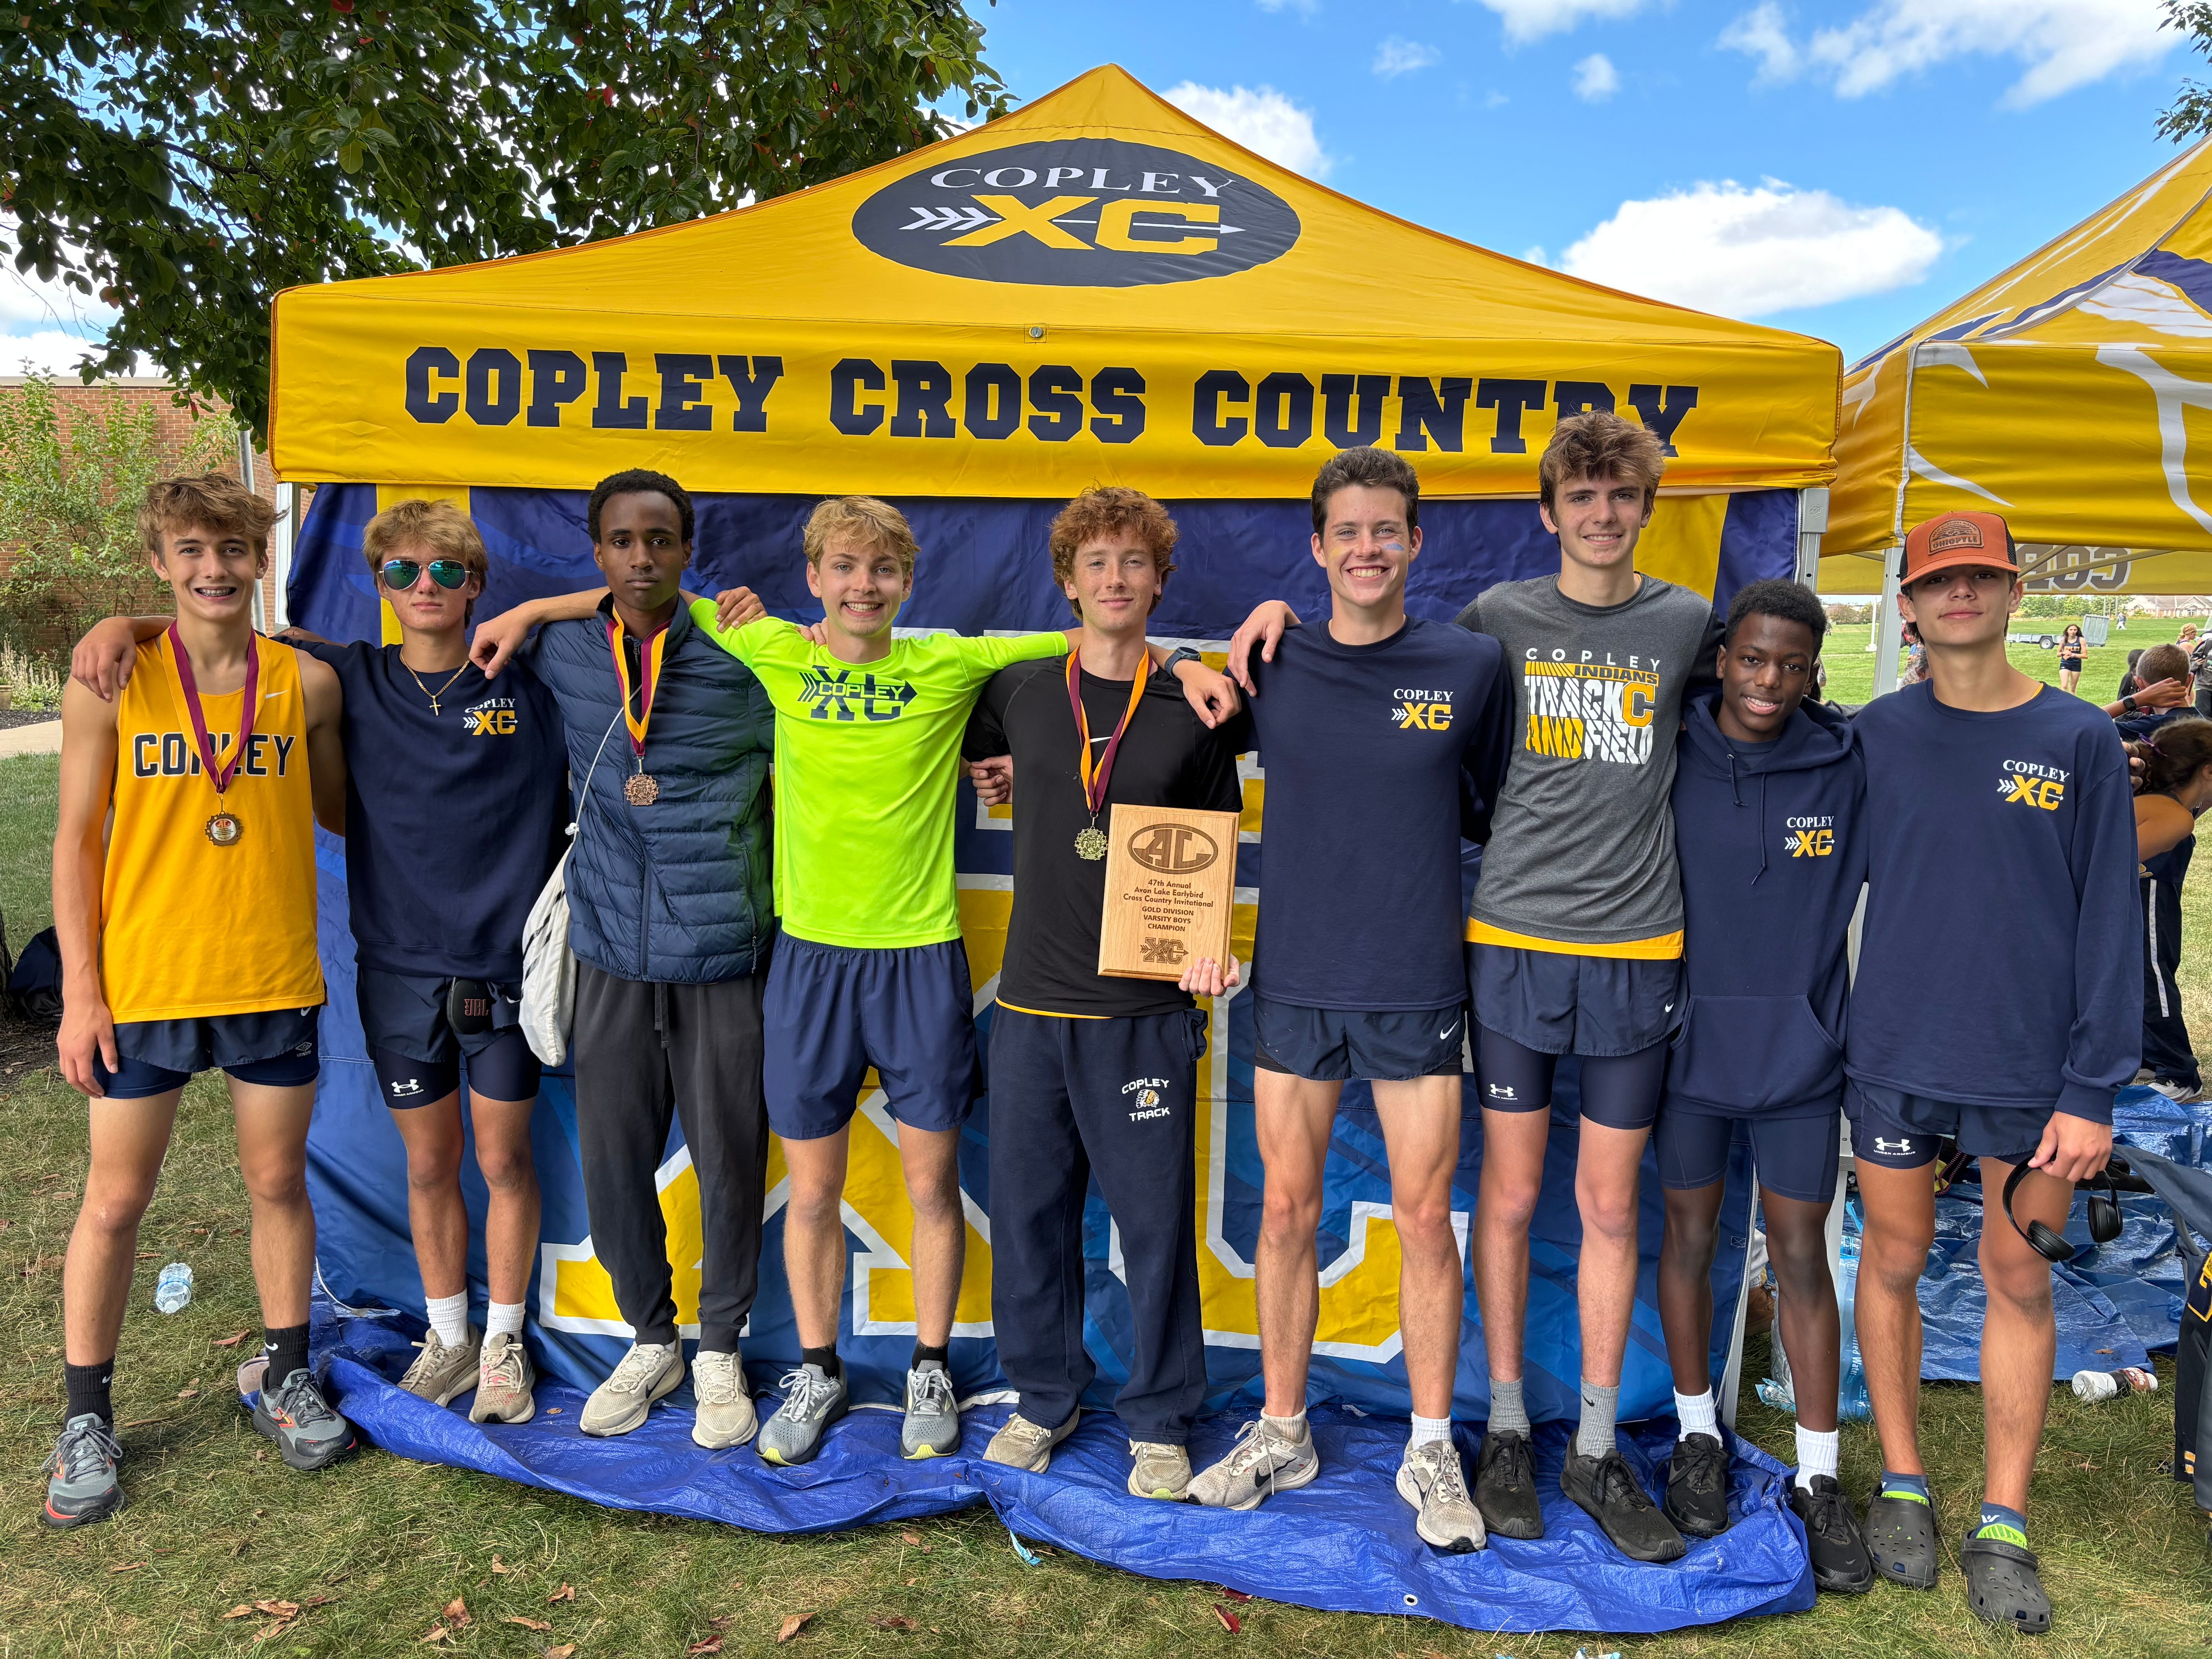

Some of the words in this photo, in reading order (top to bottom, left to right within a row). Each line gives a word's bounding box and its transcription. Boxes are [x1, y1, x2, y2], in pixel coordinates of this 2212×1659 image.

[931, 166, 1236, 198] COPLEY
[939, 195, 1219, 255] XC
[405, 346, 784, 433] COPLEY
[829, 358, 1146, 444] CROSS
[1933, 536, 1977, 548] OHIOPYLE
[1526, 648, 1660, 672] COPLEY
[1575, 665, 1657, 684] INDIANS
[818, 682, 904, 700] COPLEY
[1394, 689, 1453, 701] COPLEY
[1525, 675, 1625, 722] TRACK
[465, 698, 515, 713] COPLEY
[1622, 681, 1655, 727] C
[472, 710, 515, 735] XC
[1399, 702, 1451, 730] XC
[1526, 714, 1583, 759] AND
[1583, 719, 1654, 764] FIELD
[2003, 760, 2070, 782] COPLEY
[2005, 775, 2064, 811] XC
[1787, 816, 1834, 828] COPLEY
[1792, 829, 1832, 857] XC
[1166, 881, 1191, 889] Annual
[1172, 890, 1203, 898] Earlybird
[1123, 893, 1142, 902] Cross
[1145, 895, 1172, 905] Country
[1174, 898, 1213, 907] Invitational
[1144, 914, 1171, 922] VARSITY
[1148, 923, 1185, 932] CHAMPION
[1144, 937, 1184, 964] XC
[465, 999, 489, 1016] JBL
[1122, 1077, 1169, 1094] COPLEY
[1129, 1107, 1170, 1121] TRACK
[1850, 1357, 1862, 1375] Water
